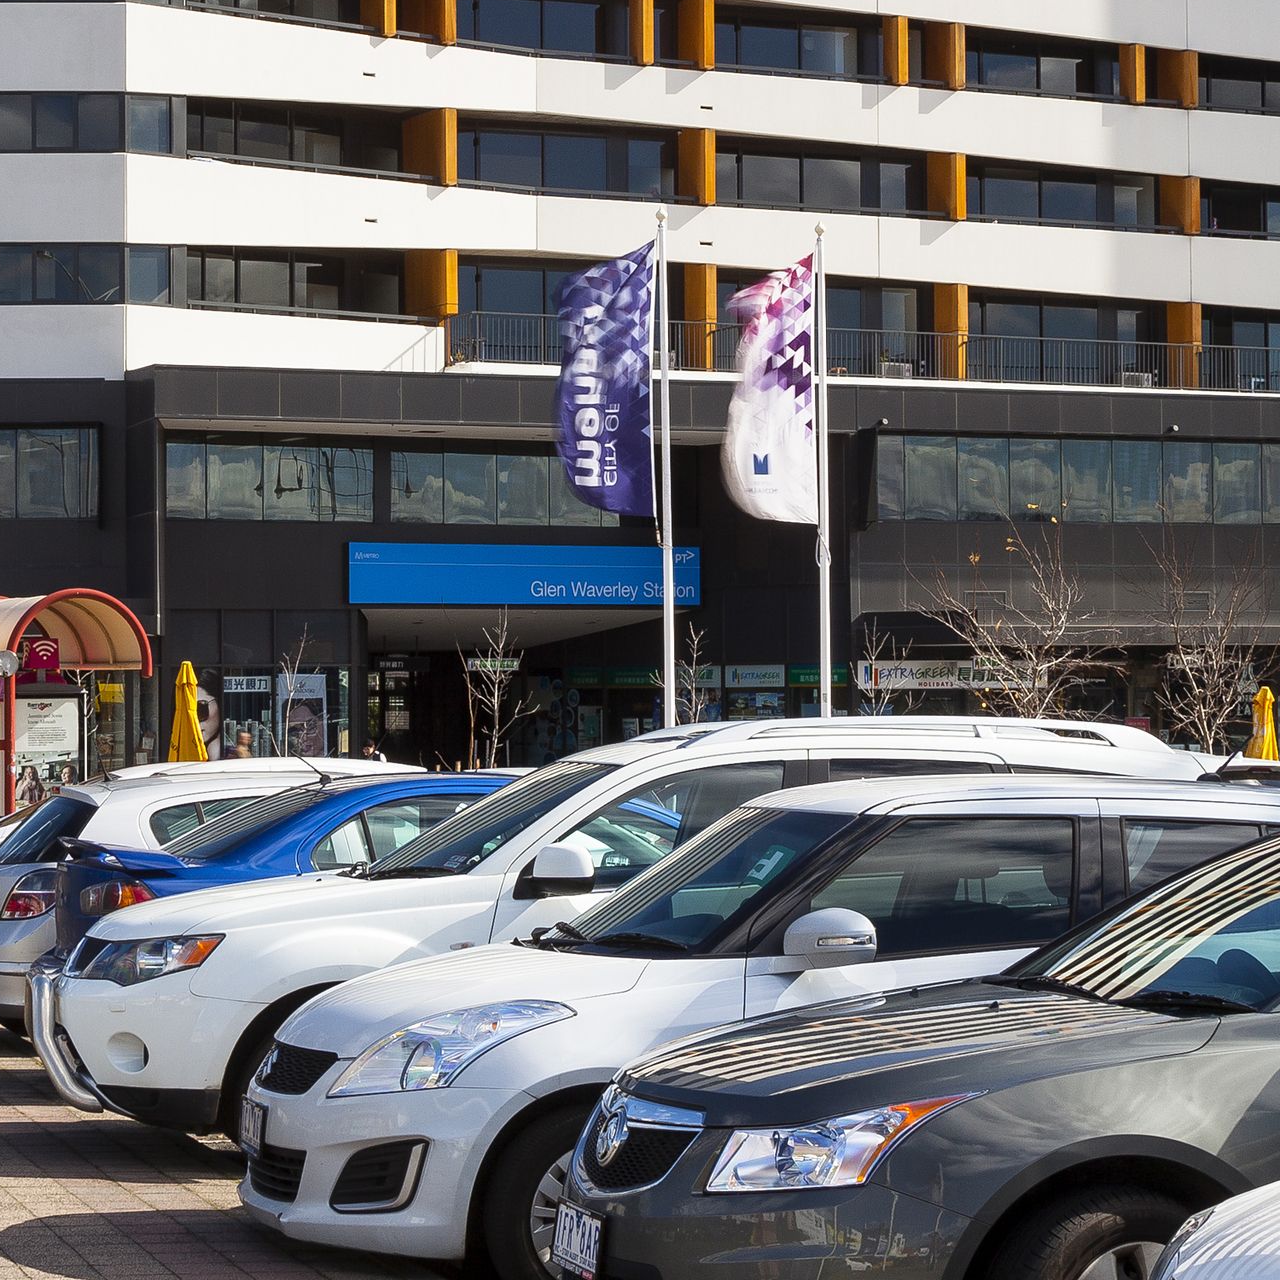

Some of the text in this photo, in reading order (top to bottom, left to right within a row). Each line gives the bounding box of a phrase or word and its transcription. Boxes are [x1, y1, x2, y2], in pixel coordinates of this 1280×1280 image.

[530, 580, 695, 602] Glen Waverley Staion
[878, 666, 959, 683] EXTRAGREEN
